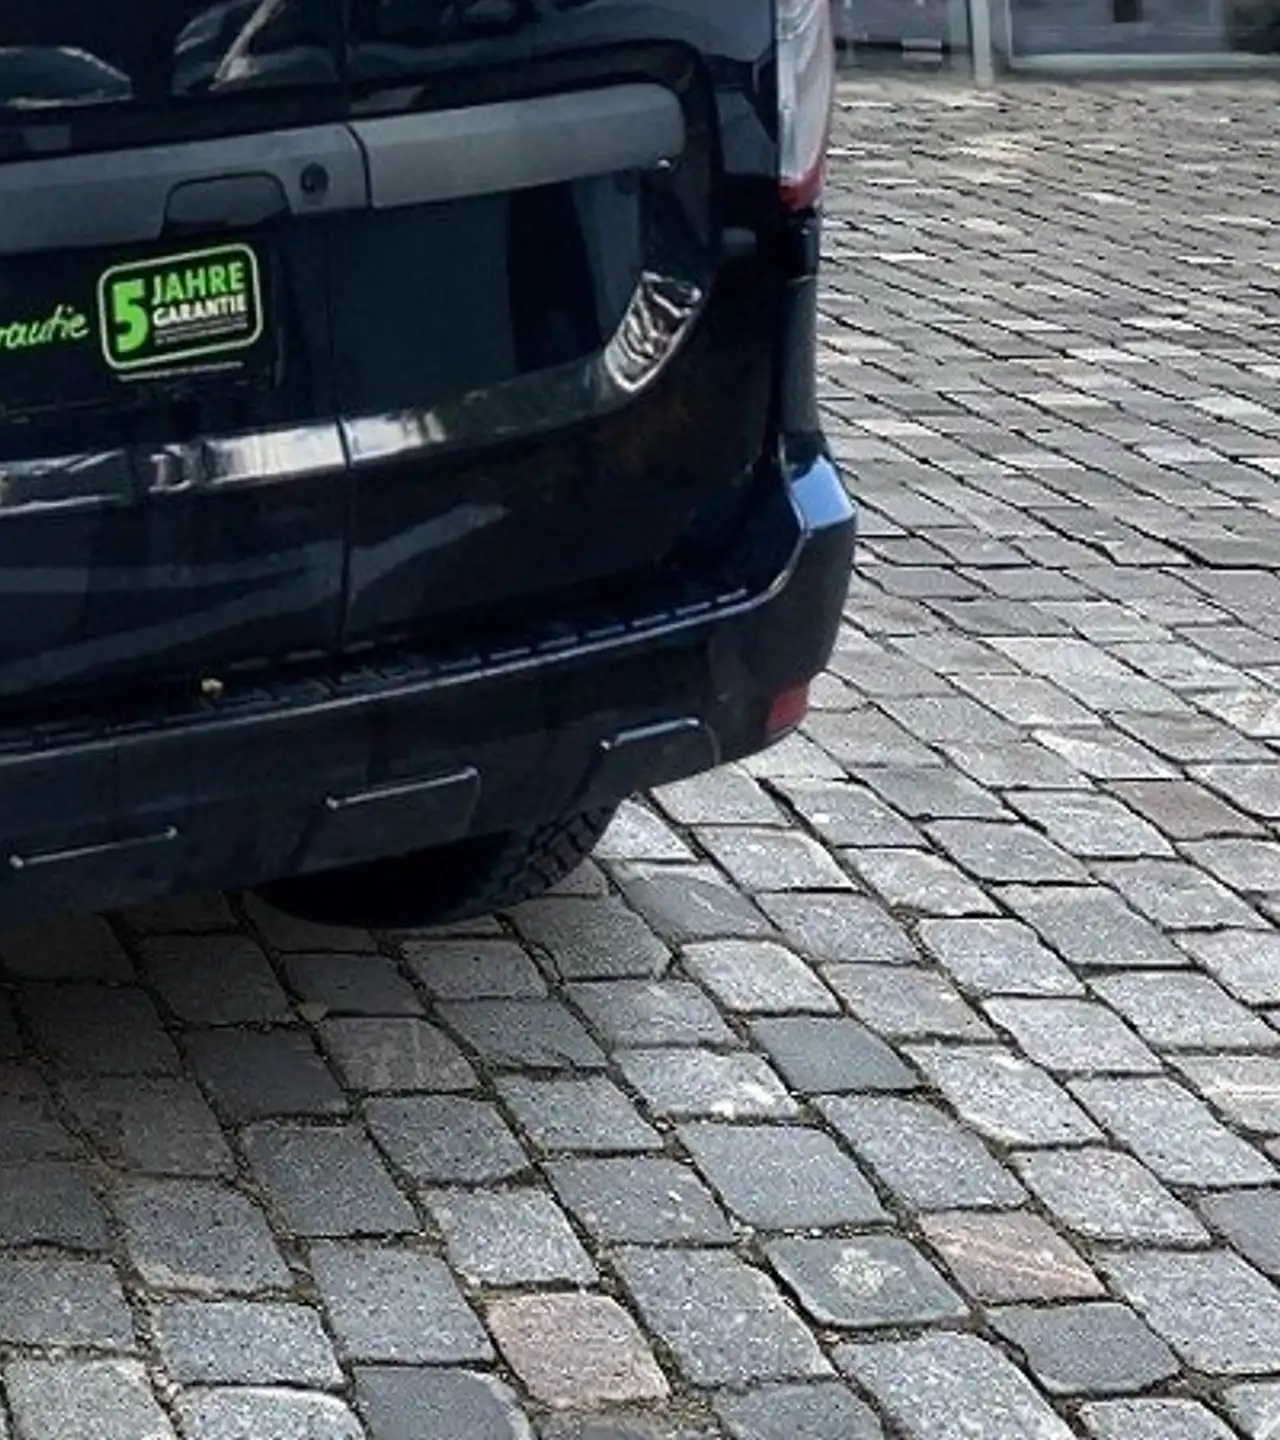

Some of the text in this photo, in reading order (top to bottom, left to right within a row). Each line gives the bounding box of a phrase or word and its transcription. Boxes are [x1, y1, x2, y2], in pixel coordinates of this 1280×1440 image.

[151, 261, 246, 306] JAHRE
[111, 278, 149, 353] 5
[152, 292, 248, 327] GARANTIE
